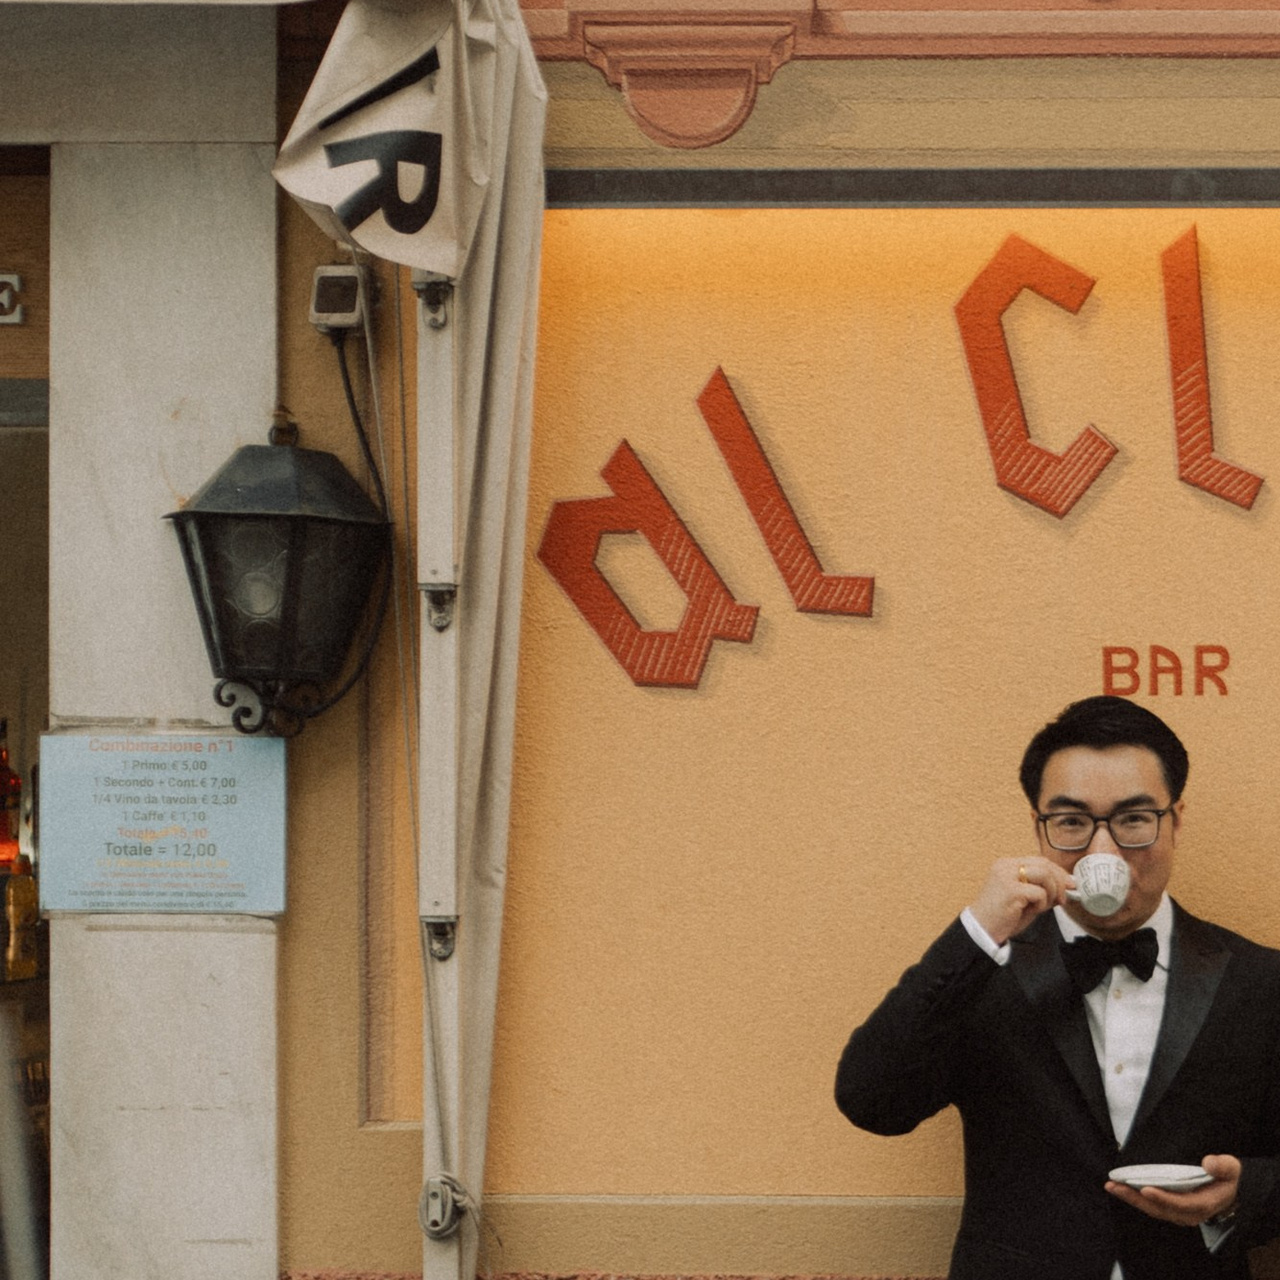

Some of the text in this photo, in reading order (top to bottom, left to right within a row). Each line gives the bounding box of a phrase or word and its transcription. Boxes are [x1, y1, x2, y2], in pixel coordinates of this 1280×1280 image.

[1101, 645, 1231, 697] BAR
[89, 738, 204, 752] Combinazione
[132, 760, 168, 770] Primo
[182, 760, 208, 772] 5,00
[104, 777, 154, 787] Secondo
[210, 777, 237, 789] 7,00
[115, 794, 141, 804] Vino
[144, 794, 158, 804] da
[212, 794, 238, 806] 2,30
[104, 841, 153, 856] Totale
[174, 842, 217, 859] 12,00
